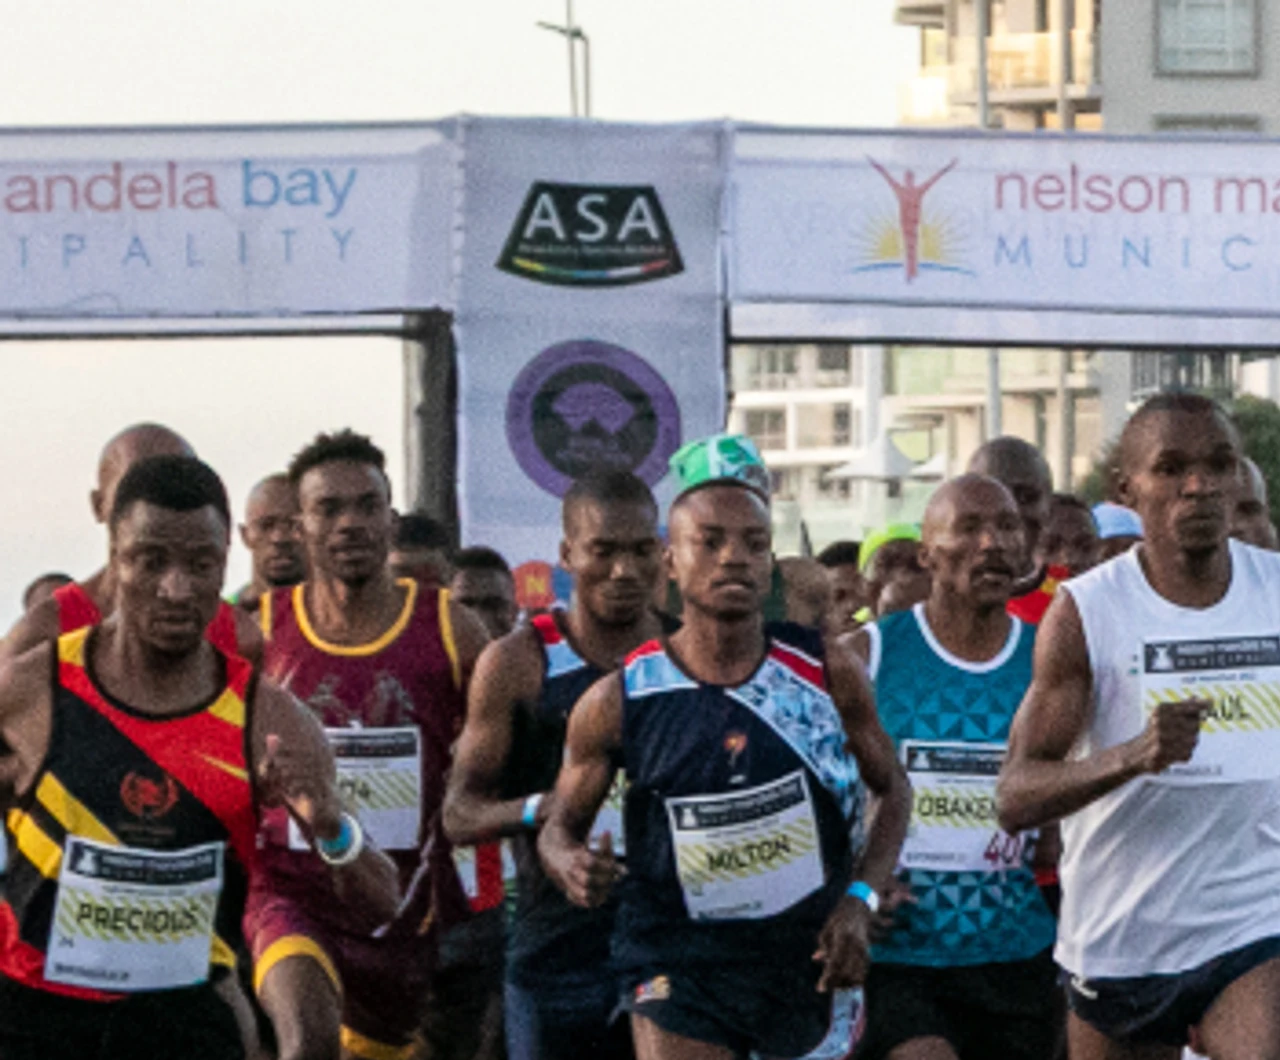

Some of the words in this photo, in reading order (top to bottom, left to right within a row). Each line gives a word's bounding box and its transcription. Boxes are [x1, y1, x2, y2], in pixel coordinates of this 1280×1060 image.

[241, 159, 358, 219] bay
[994, 161, 1190, 214] nelson
[522, 192, 661, 242] ASA
[705, 833, 791, 872] MILTON
[76, 902, 199, 934] PRECIOUS
